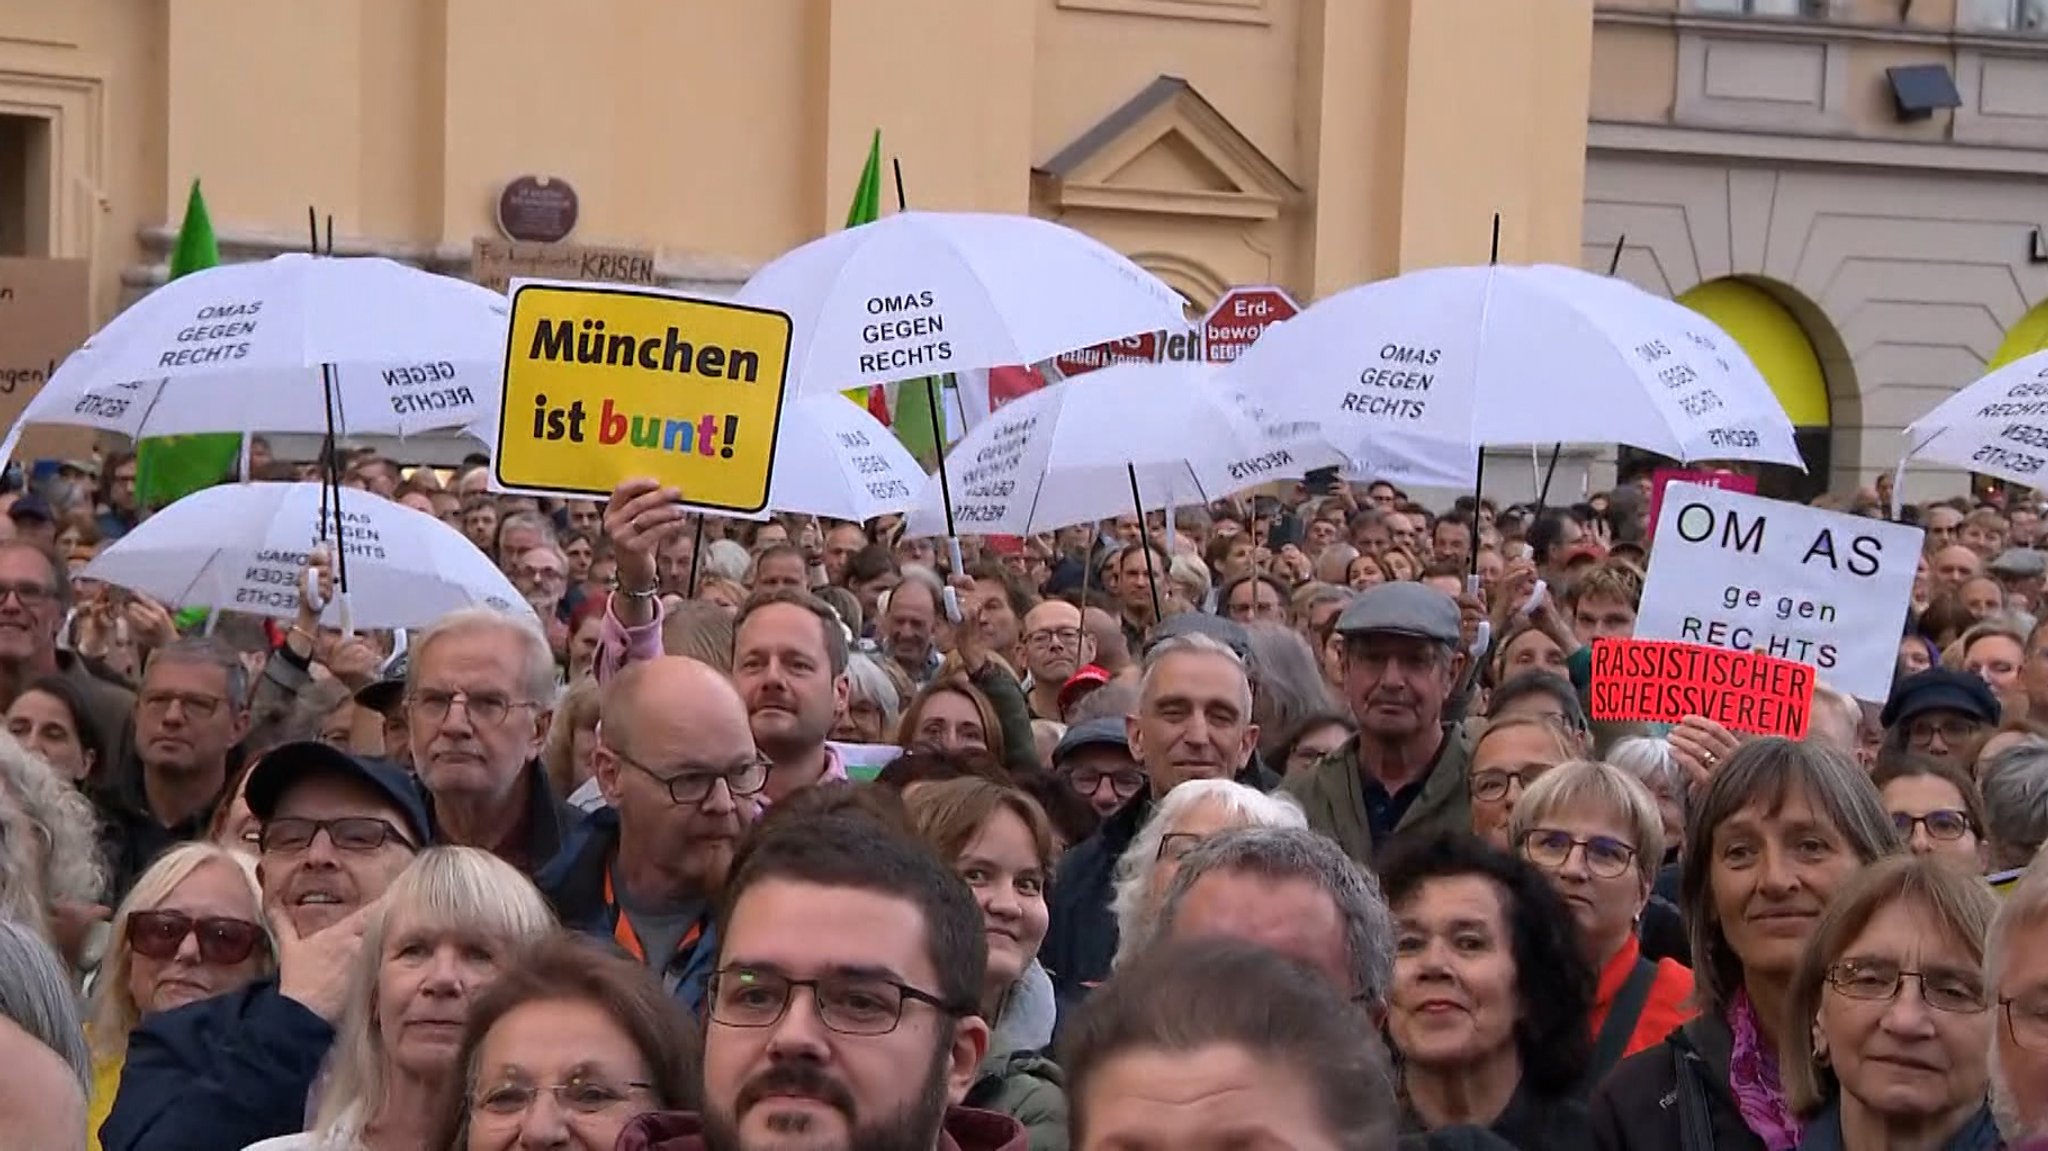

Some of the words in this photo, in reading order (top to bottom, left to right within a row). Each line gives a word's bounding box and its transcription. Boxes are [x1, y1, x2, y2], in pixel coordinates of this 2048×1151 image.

[581, 252, 652, 283] KRISEN
[196, 301, 263, 319] OMAS
[867, 291, 933, 314] OMAS
[1234, 300, 1275, 318] Erd-
[177, 321, 256, 342] GEGEN
[863, 314, 943, 343] GEGEN
[158, 343, 250, 367] RECHTS
[529, 319, 759, 382] München
[860, 341, 952, 373] RECHTS
[1380, 344, 1441, 365] OMAS
[1361, 367, 1434, 390] GEGEN
[1341, 392, 1425, 419] RECHTS
[533, 394, 585, 442] ist
[600, 399, 739, 459] bunt!
[1595, 645, 1807, 701] RASSISTISCHER
[1595, 681, 1804, 738] SCHEISSVEREIN
